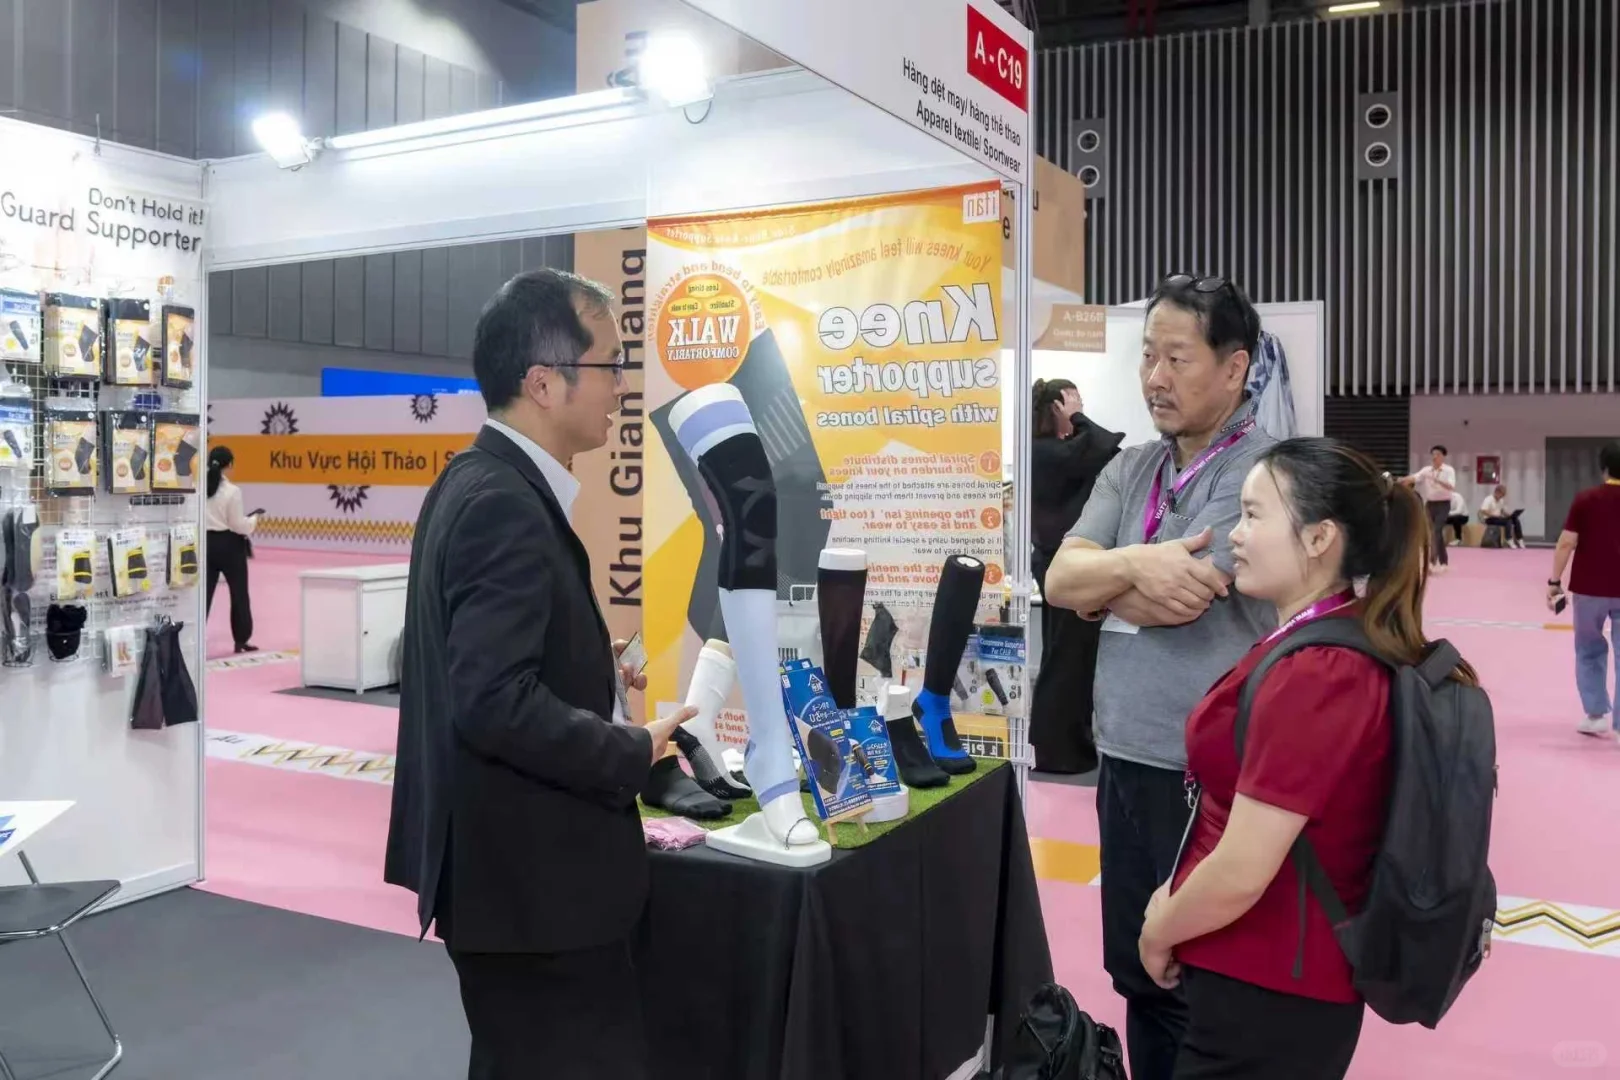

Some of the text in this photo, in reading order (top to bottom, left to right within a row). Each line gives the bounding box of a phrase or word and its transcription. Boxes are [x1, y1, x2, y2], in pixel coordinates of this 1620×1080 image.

[903, 57, 1021, 146] Hàng dệt may/ hàng thể thao
[916, 100, 952, 136] Apparel
[983, 138, 1021, 174] Sportwear
[0, 191, 201, 252] Guard Supporter
[89, 188, 204, 225] Don't Hold it!
[270, 450, 302, 469] Khu
[307, 451, 342, 473] Vực
[347, 451, 376, 474] Hội
[382, 450, 427, 470] Thảo
[609, 392, 643, 497] Gian
[1155, 502, 1168, 520] VIATT
[609, 516, 643, 607] Khu
